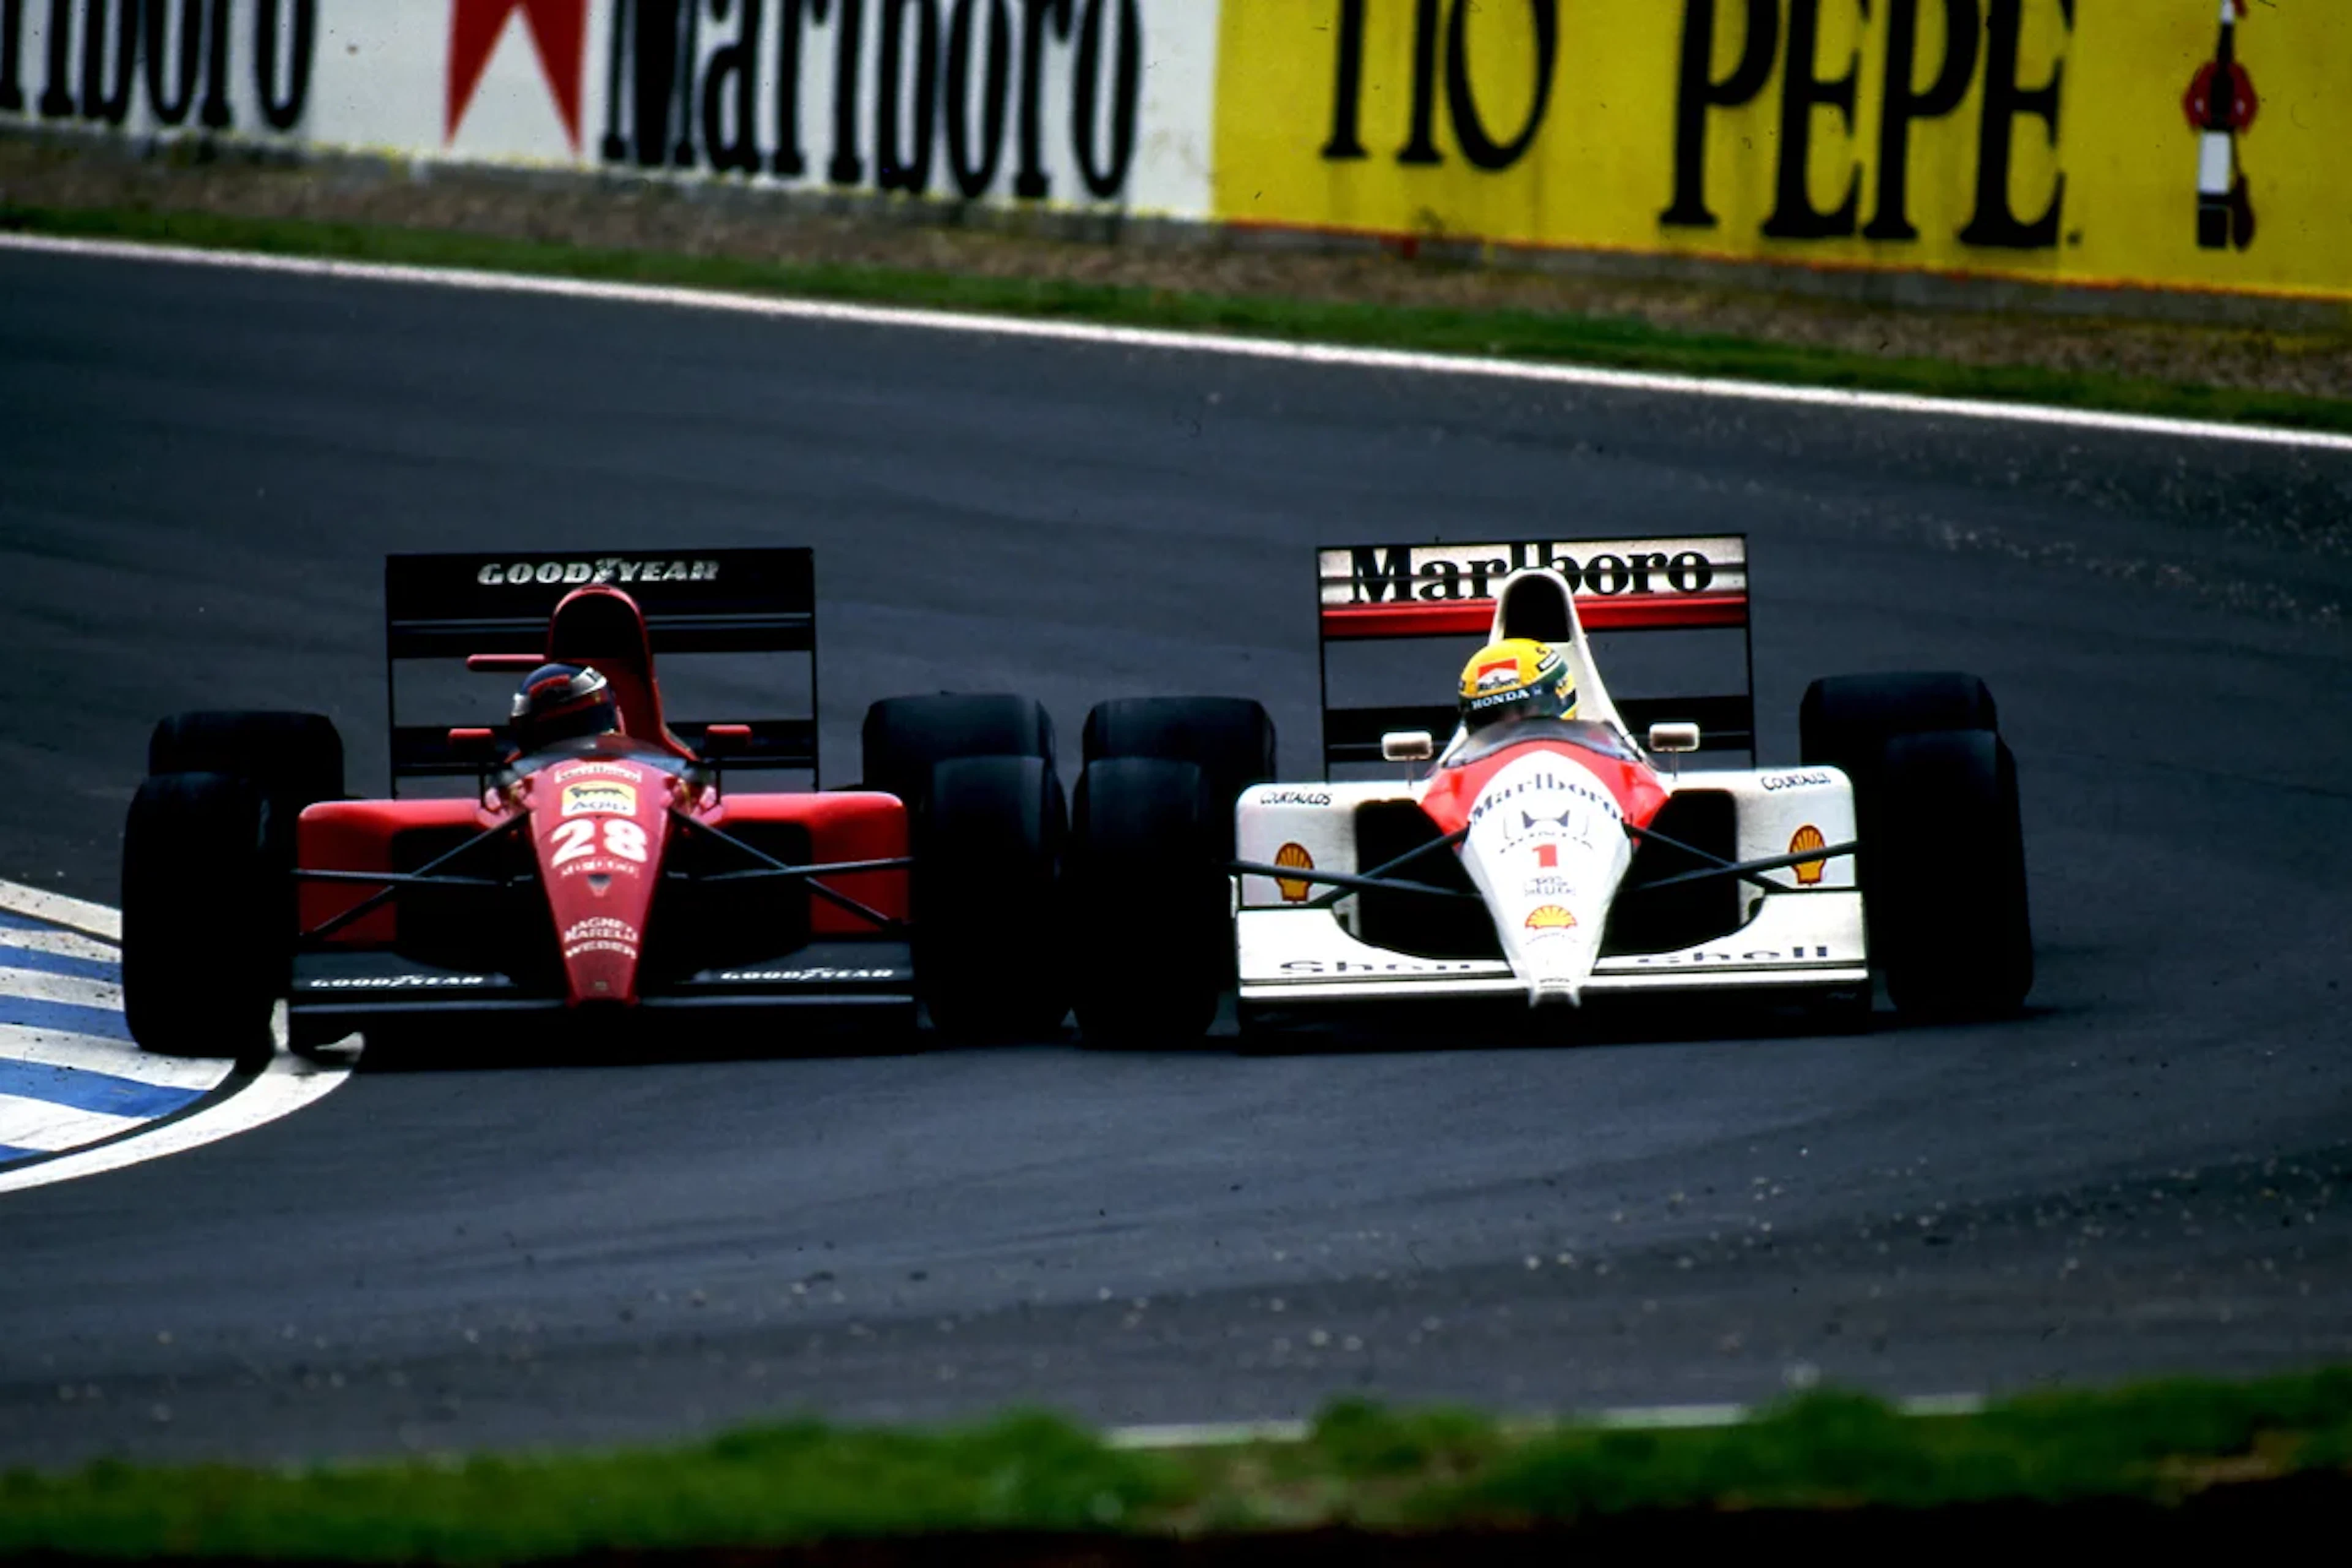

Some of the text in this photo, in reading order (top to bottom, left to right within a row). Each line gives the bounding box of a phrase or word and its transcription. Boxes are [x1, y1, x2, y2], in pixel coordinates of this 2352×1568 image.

[1471, 688, 1530, 710] HONDA
[1472, 772, 1619, 826] Marlboro
[551, 819, 647, 868] 28
[1532, 843, 1558, 868] 1
